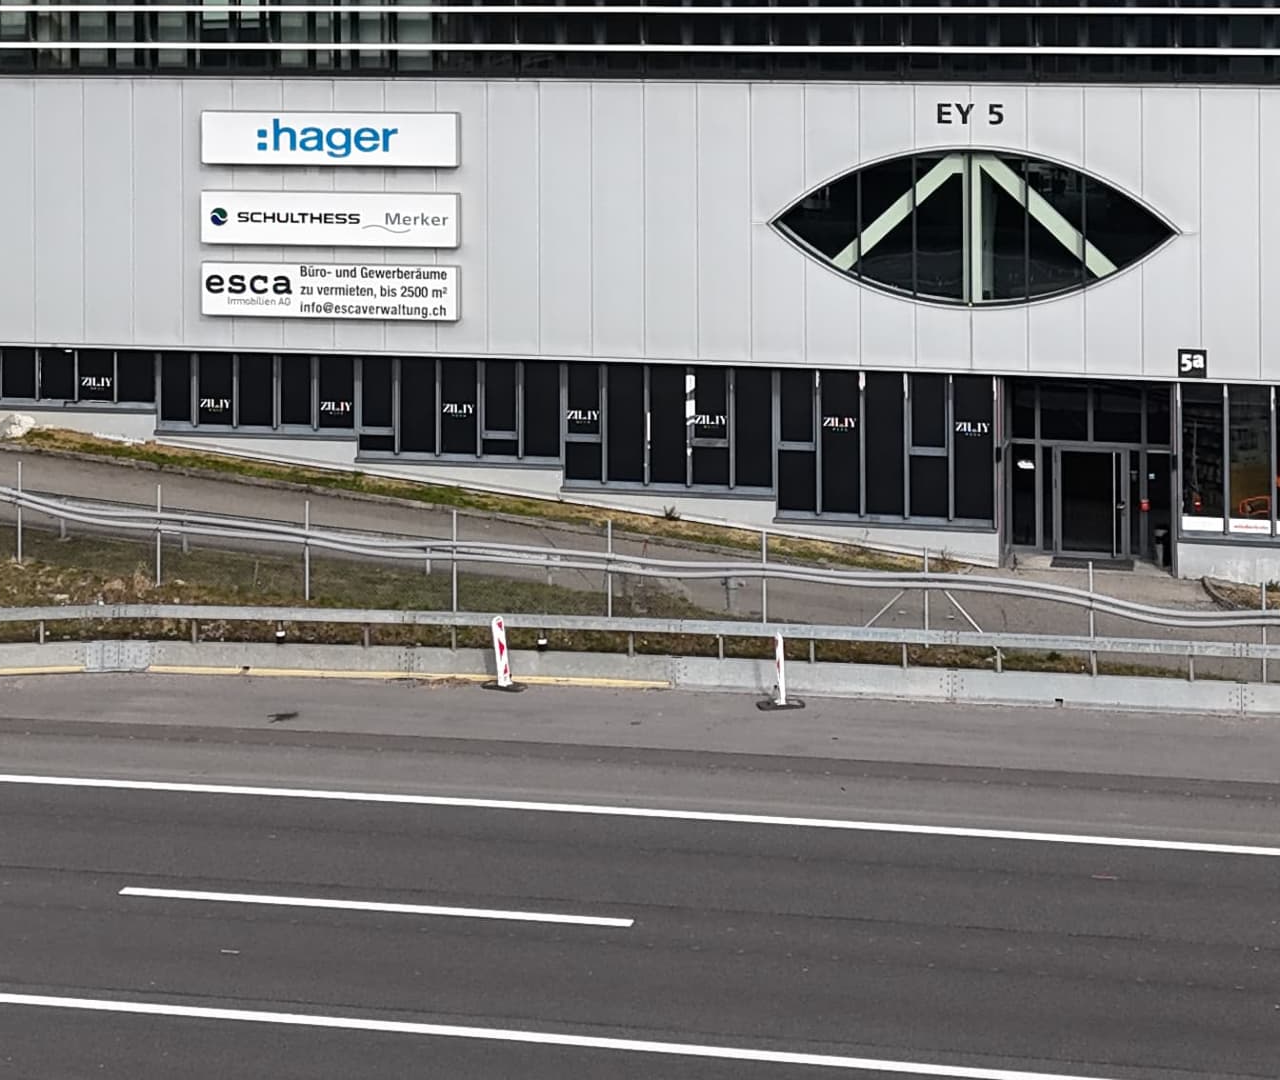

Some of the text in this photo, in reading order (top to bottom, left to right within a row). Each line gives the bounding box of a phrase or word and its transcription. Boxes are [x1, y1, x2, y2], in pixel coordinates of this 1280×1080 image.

[937, 103, 1004, 125] EY 5
[237, 212, 361, 225] SCHULTHESS
[385, 212, 448, 226] Merker
[300, 265, 448, 280] Büro- und Gewerberäume
[205, 274, 293, 295] esca
[300, 286, 313, 295] zu
[317, 284, 377, 299] vermieten,
[380, 285, 397, 297] bis
[400, 286, 428, 298] 2500
[300, 301, 447, 319] info@escaverwaltung.ch
[1181, 354, 1205, 372] 5a
